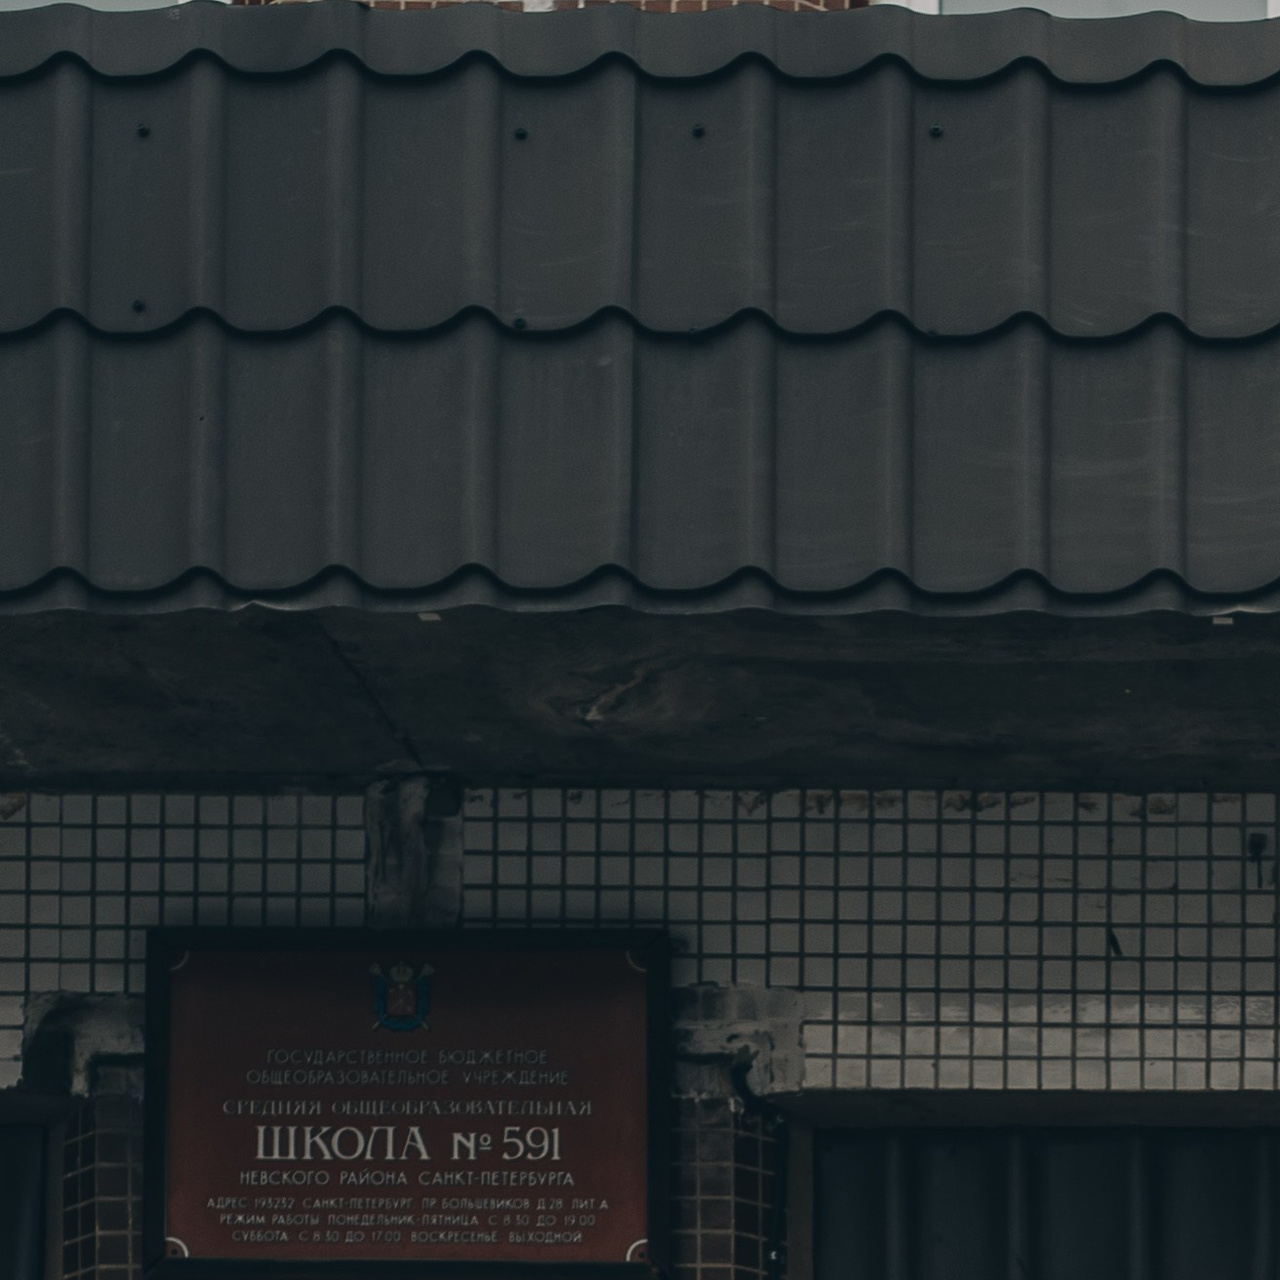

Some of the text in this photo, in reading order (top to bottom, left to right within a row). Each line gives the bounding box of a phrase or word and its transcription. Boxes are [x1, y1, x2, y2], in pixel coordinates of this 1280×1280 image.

[266, 1049, 549, 1065] ГОСУДАРСТВЕННОЕ БЮДЖЕТНОЕ
[246, 1069, 570, 1085] ОБЩЕОБРАЗОВАТЕЛЬНОЕ УЧРЕЖДЕНИЕ
[222, 1099, 593, 1116] СРЕДНЯЯ ОБЩЕОБРАЗОВАТЕЛЬНАЯ
[254, 1125, 563, 1161] ШКОЛА № 591
[239, 1168, 576, 1187] НЕВСКОГО РАЙОНА САНКТ-ПЕТЕРБУРГА
[219, 1213, 266, 1226] РЕЖИМ
[535, 1215, 557, 1227] ДО
[344, 1230, 365, 1244] ДО
[508, 1230, 583, 1244] ВЫХОДНОЙ
